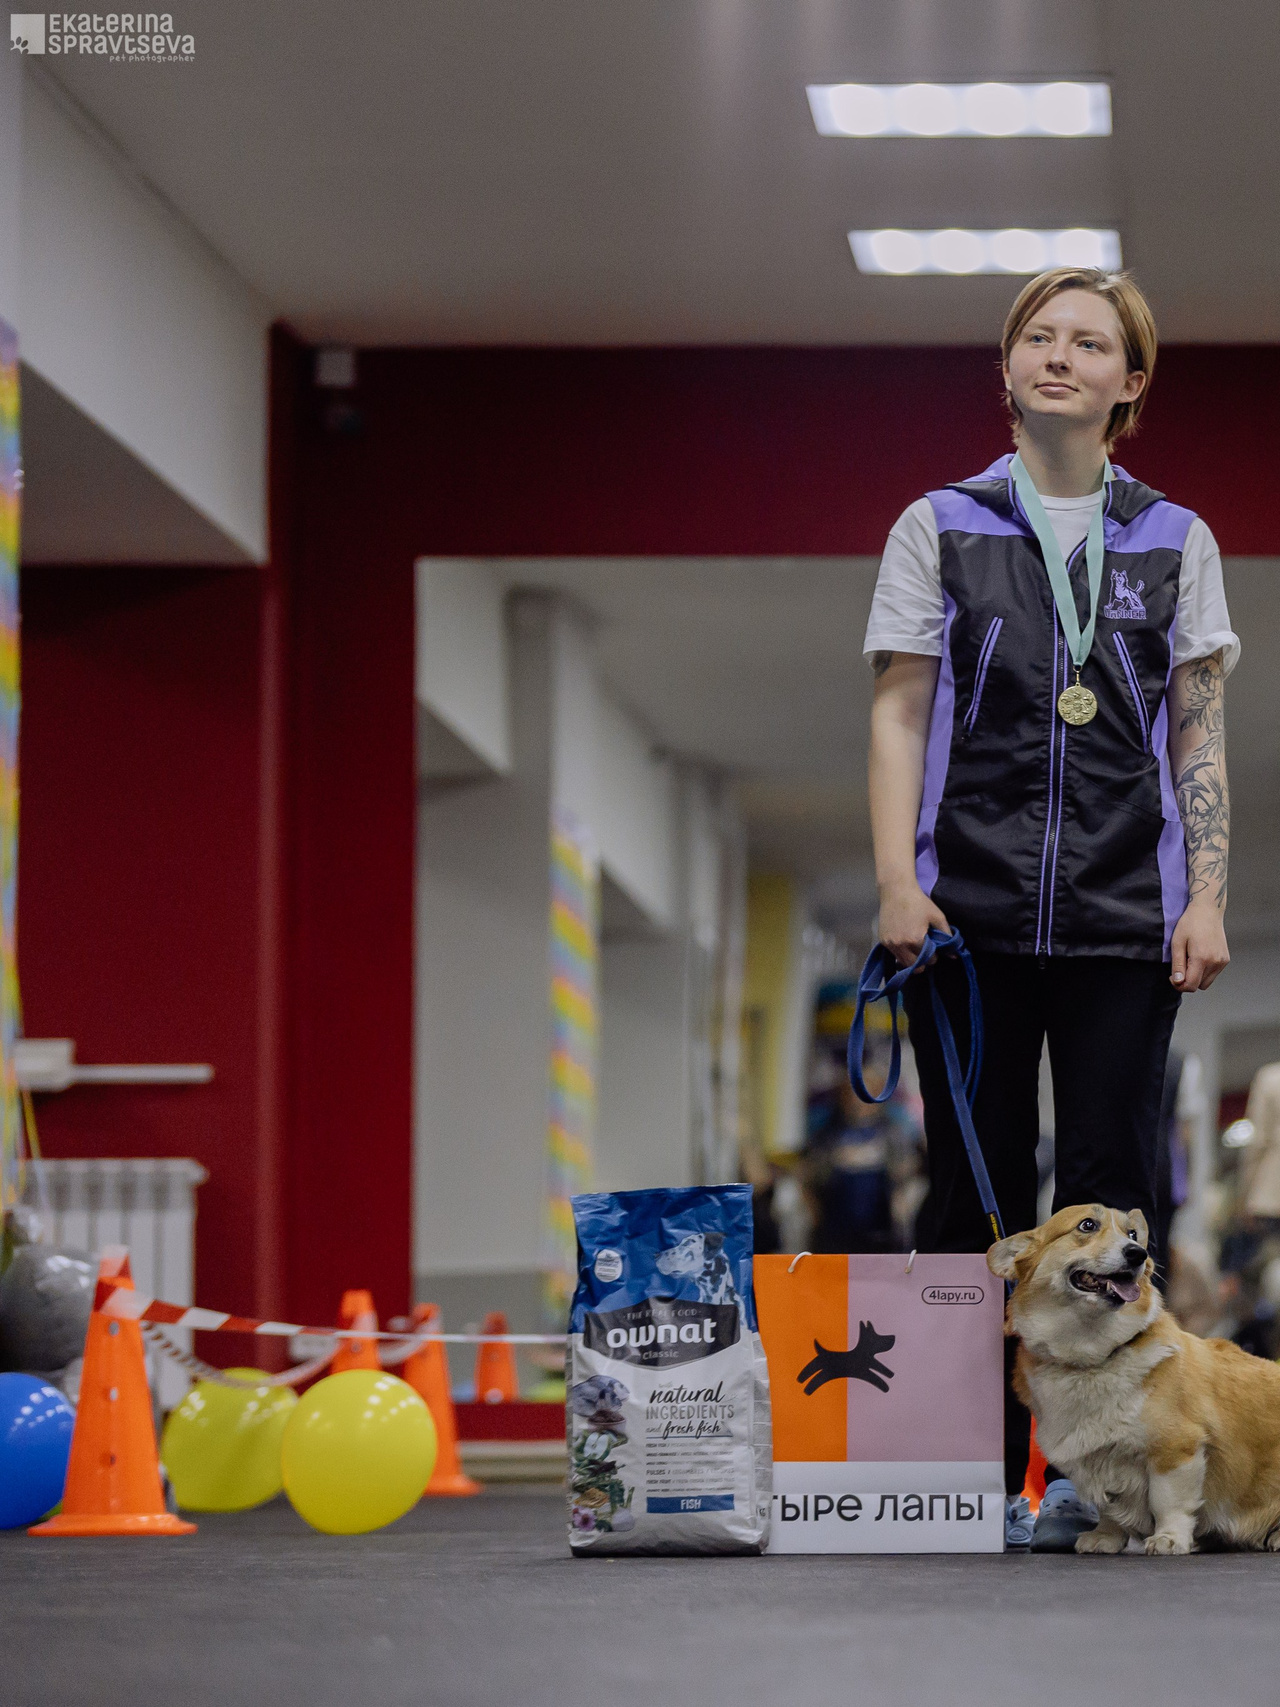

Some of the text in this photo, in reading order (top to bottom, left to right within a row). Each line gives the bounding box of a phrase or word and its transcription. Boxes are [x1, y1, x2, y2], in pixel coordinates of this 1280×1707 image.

[928, 1290, 976, 1303] 4lapy.ru
[672, 1308, 698, 1317] FOOD
[606, 1318, 718, 1349] ownat
[649, 1380, 726, 1405] natural
[645, 1404, 735, 1420] INGREDIENTS
[663, 1420, 695, 1440] fresh
[695, 1420, 721, 1440] fish
[680, 1498, 702, 1510] FISH
[874, 1494, 984, 1522] лапы
